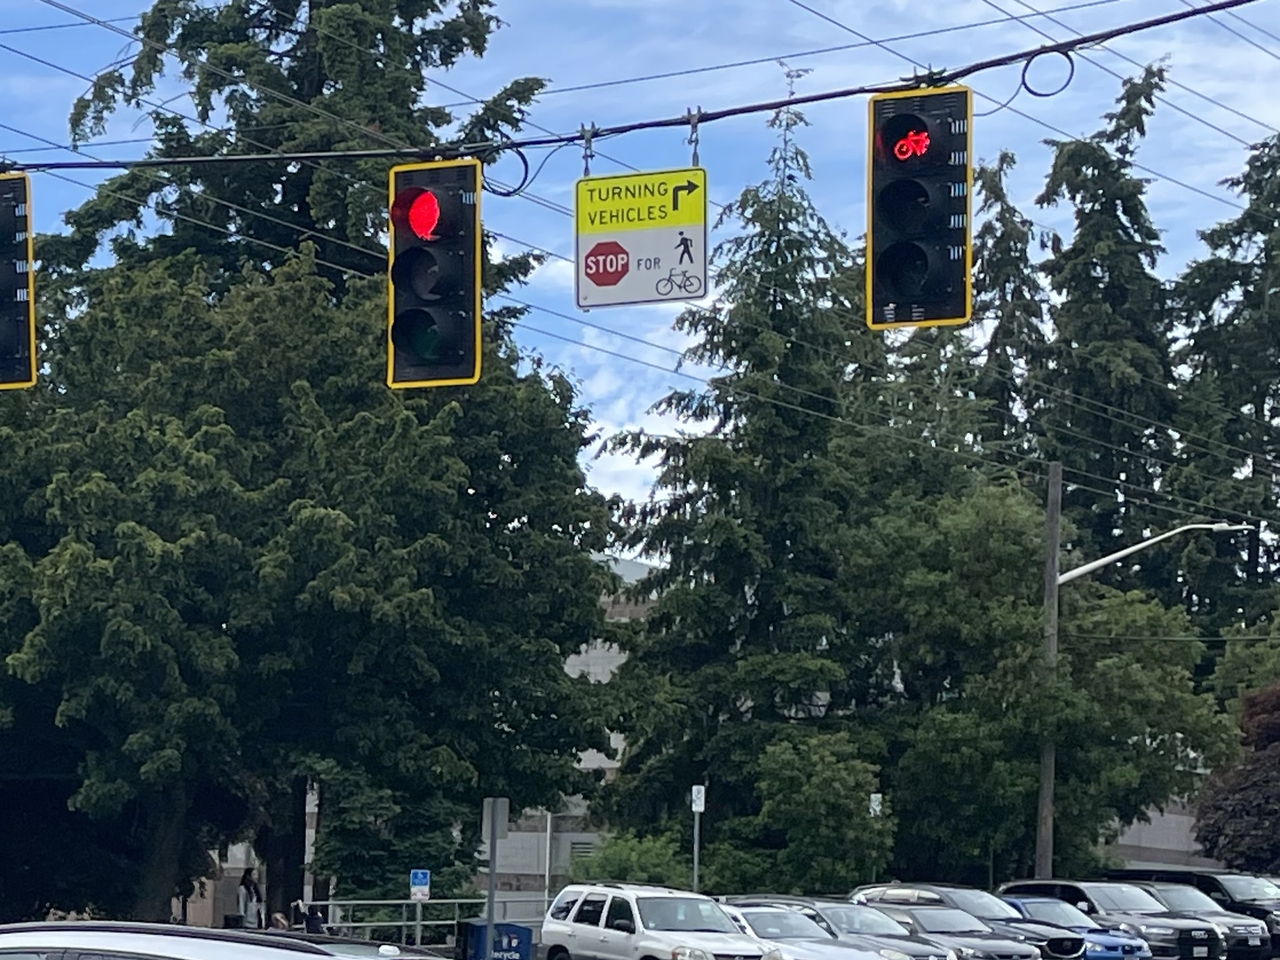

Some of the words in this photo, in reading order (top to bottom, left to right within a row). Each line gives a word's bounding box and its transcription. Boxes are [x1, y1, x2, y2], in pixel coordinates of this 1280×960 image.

[586, 182, 668, 202] TURNING
[587, 205, 668, 226] VEHICLES
[586, 254, 628, 274] STOP
[636, 257, 661, 271] FOR
